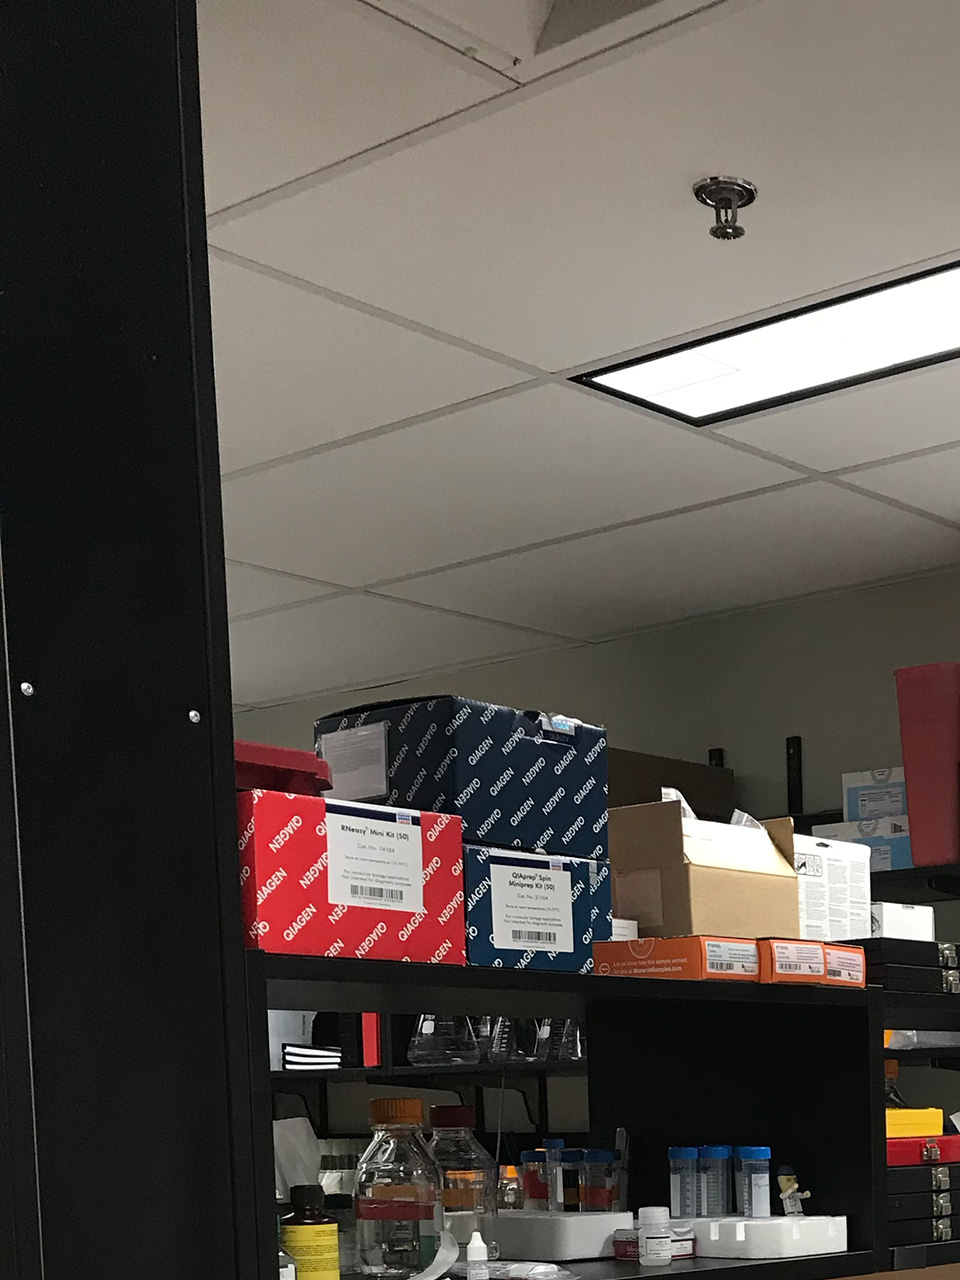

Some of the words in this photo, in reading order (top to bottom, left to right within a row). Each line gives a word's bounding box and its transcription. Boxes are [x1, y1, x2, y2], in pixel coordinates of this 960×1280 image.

[445, 705, 473, 736] QIAGEN
[416, 722, 438, 757] QIAGEN
[468, 736, 494, 766] QIAGEN
[584, 738, 607, 766] QIAGEN
[388, 744, 410, 778] QIAGEN
[434, 748, 458, 782] QIAGEN
[522, 757, 546, 786] QIAGEN
[554, 748, 578, 775] QIAGEN
[406, 768, 428, 802] QIAGEN
[454, 778, 481, 808] QIAGEN
[489, 767, 515, 796] QIAGEN
[573, 776, 597, 805] QIAGEN
[510, 797, 535, 826] QIAGEN
[542, 786, 566, 816] QIAGEN
[268, 815, 303, 853] QIAGEN
[397, 833, 409, 841] (50)
[476, 808, 502, 838] QIAGEN
[562, 816, 586, 845] QIAGEN
[509, 881, 534, 889] Miniprep
[544, 883, 555, 891] (50)
[283, 903, 317, 942] QIAGEN
[437, 890, 465, 926] QIAGEN
[354, 922, 388, 959] QIAGEN
